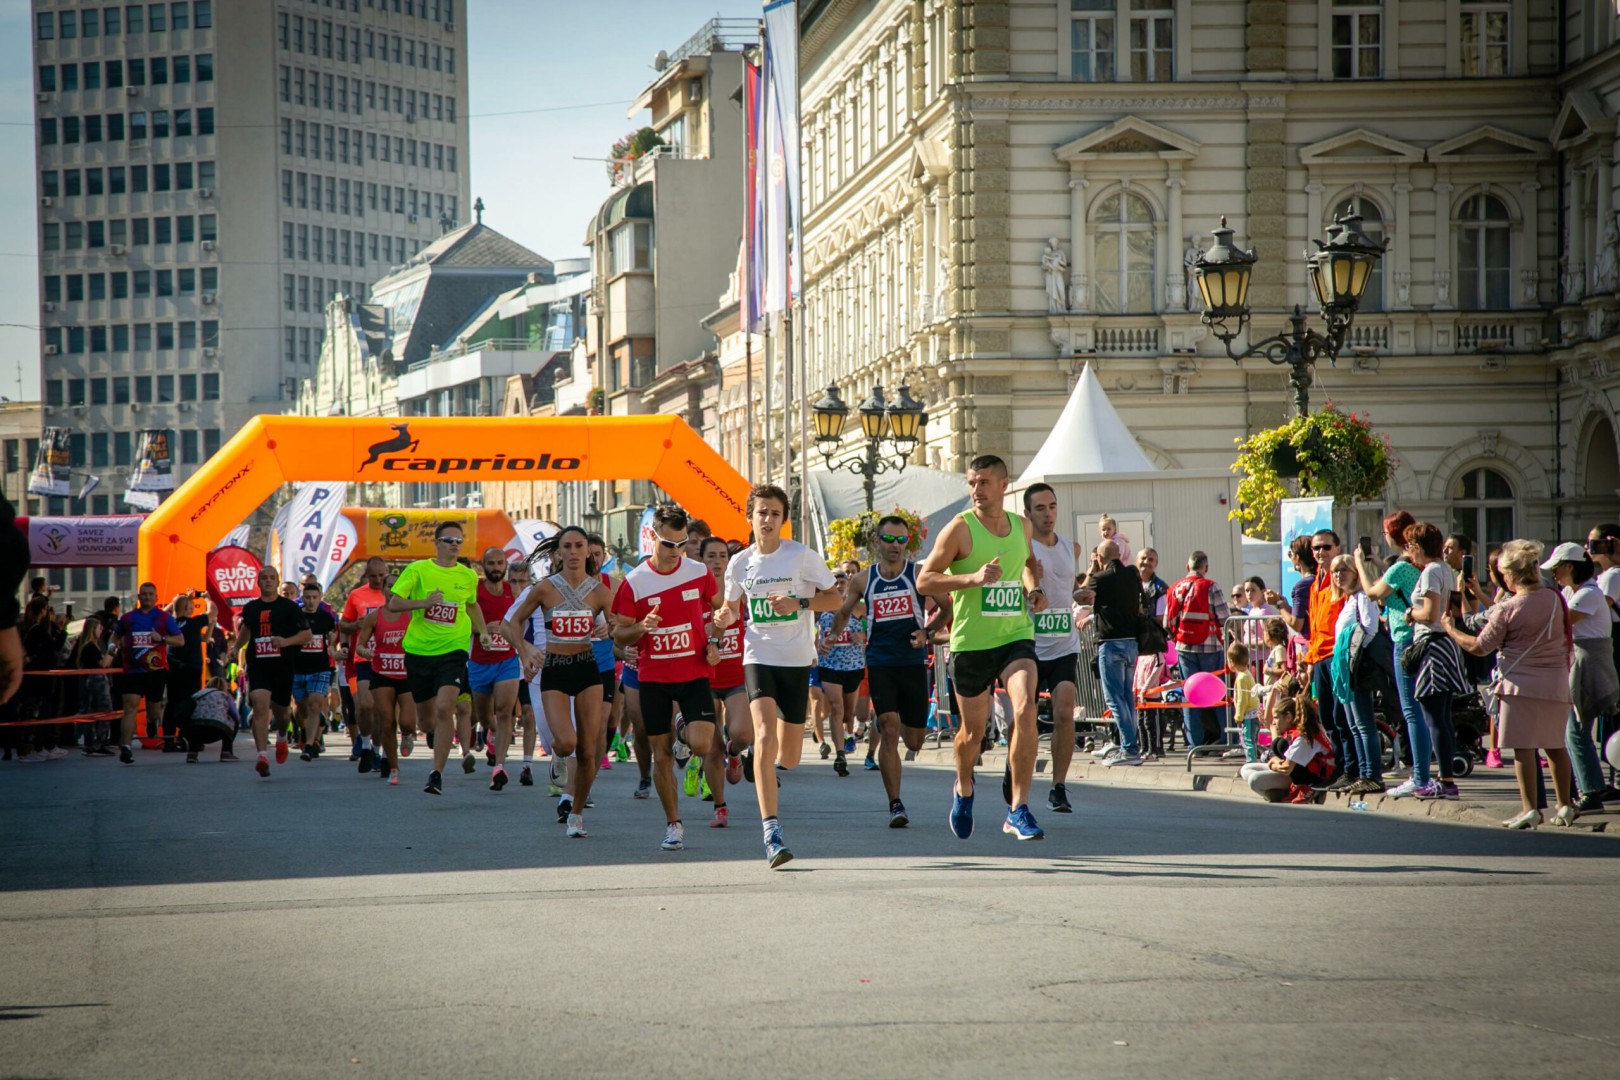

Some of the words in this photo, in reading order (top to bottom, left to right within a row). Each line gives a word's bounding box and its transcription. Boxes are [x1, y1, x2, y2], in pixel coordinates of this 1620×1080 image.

[383, 454, 580, 474] capriolo
[77, 536, 104, 544] SPORT
[106, 536, 117, 544] ZA
[119, 536, 134, 544] SVE
[985, 588, 1021, 607] 4002
[427, 605, 456, 620] 3260
[877, 597, 910, 615] 3223
[555, 617, 590, 634] 3153
[1038, 614, 1069, 630] 4078
[133, 635, 152, 645] 3231
[652, 631, 691, 652] 3120
[382, 659, 405, 669] 3161
